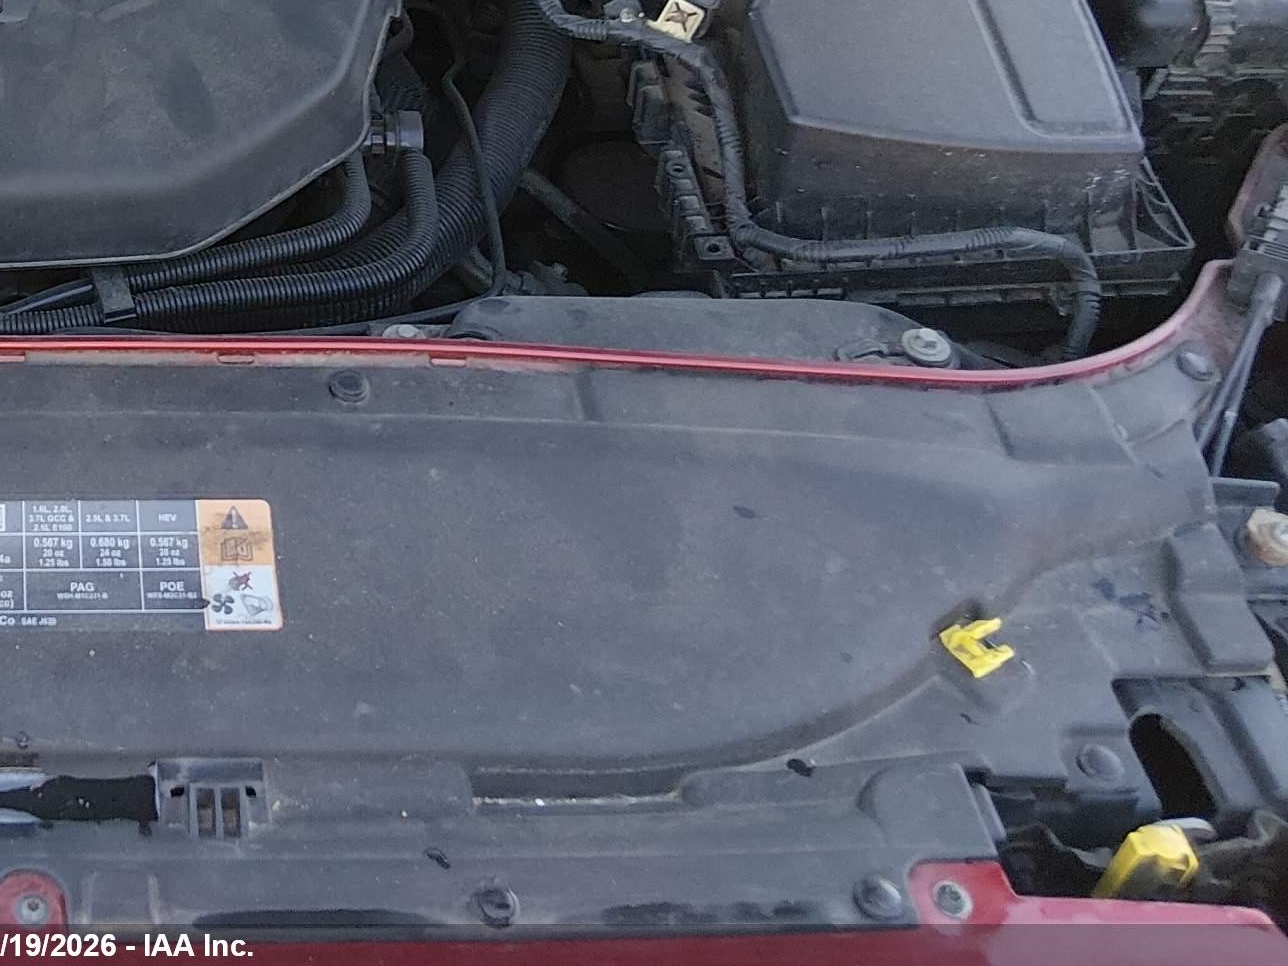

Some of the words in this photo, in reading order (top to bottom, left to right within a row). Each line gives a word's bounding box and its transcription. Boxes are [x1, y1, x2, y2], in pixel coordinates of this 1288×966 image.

[158, 513, 177, 522] HEV
[34, 537, 59, 548] 0.567
[60, 537, 73, 550] kg
[117, 537, 130, 550] kg
[176, 537, 188, 550] kg
[54, 550, 64, 558] oz
[111, 549, 121, 557] oz
[39, 558, 55, 567] 1.25
[56, 558, 70, 567] lbs
[114, 558, 127, 566] lbs
[172, 558, 186, 566] lbs
[70, 582, 95, 592] PAG
[159, 581, 184, 592] POE
[0, 590, 13, 598] oz
[21, 617, 38, 626] SAE
